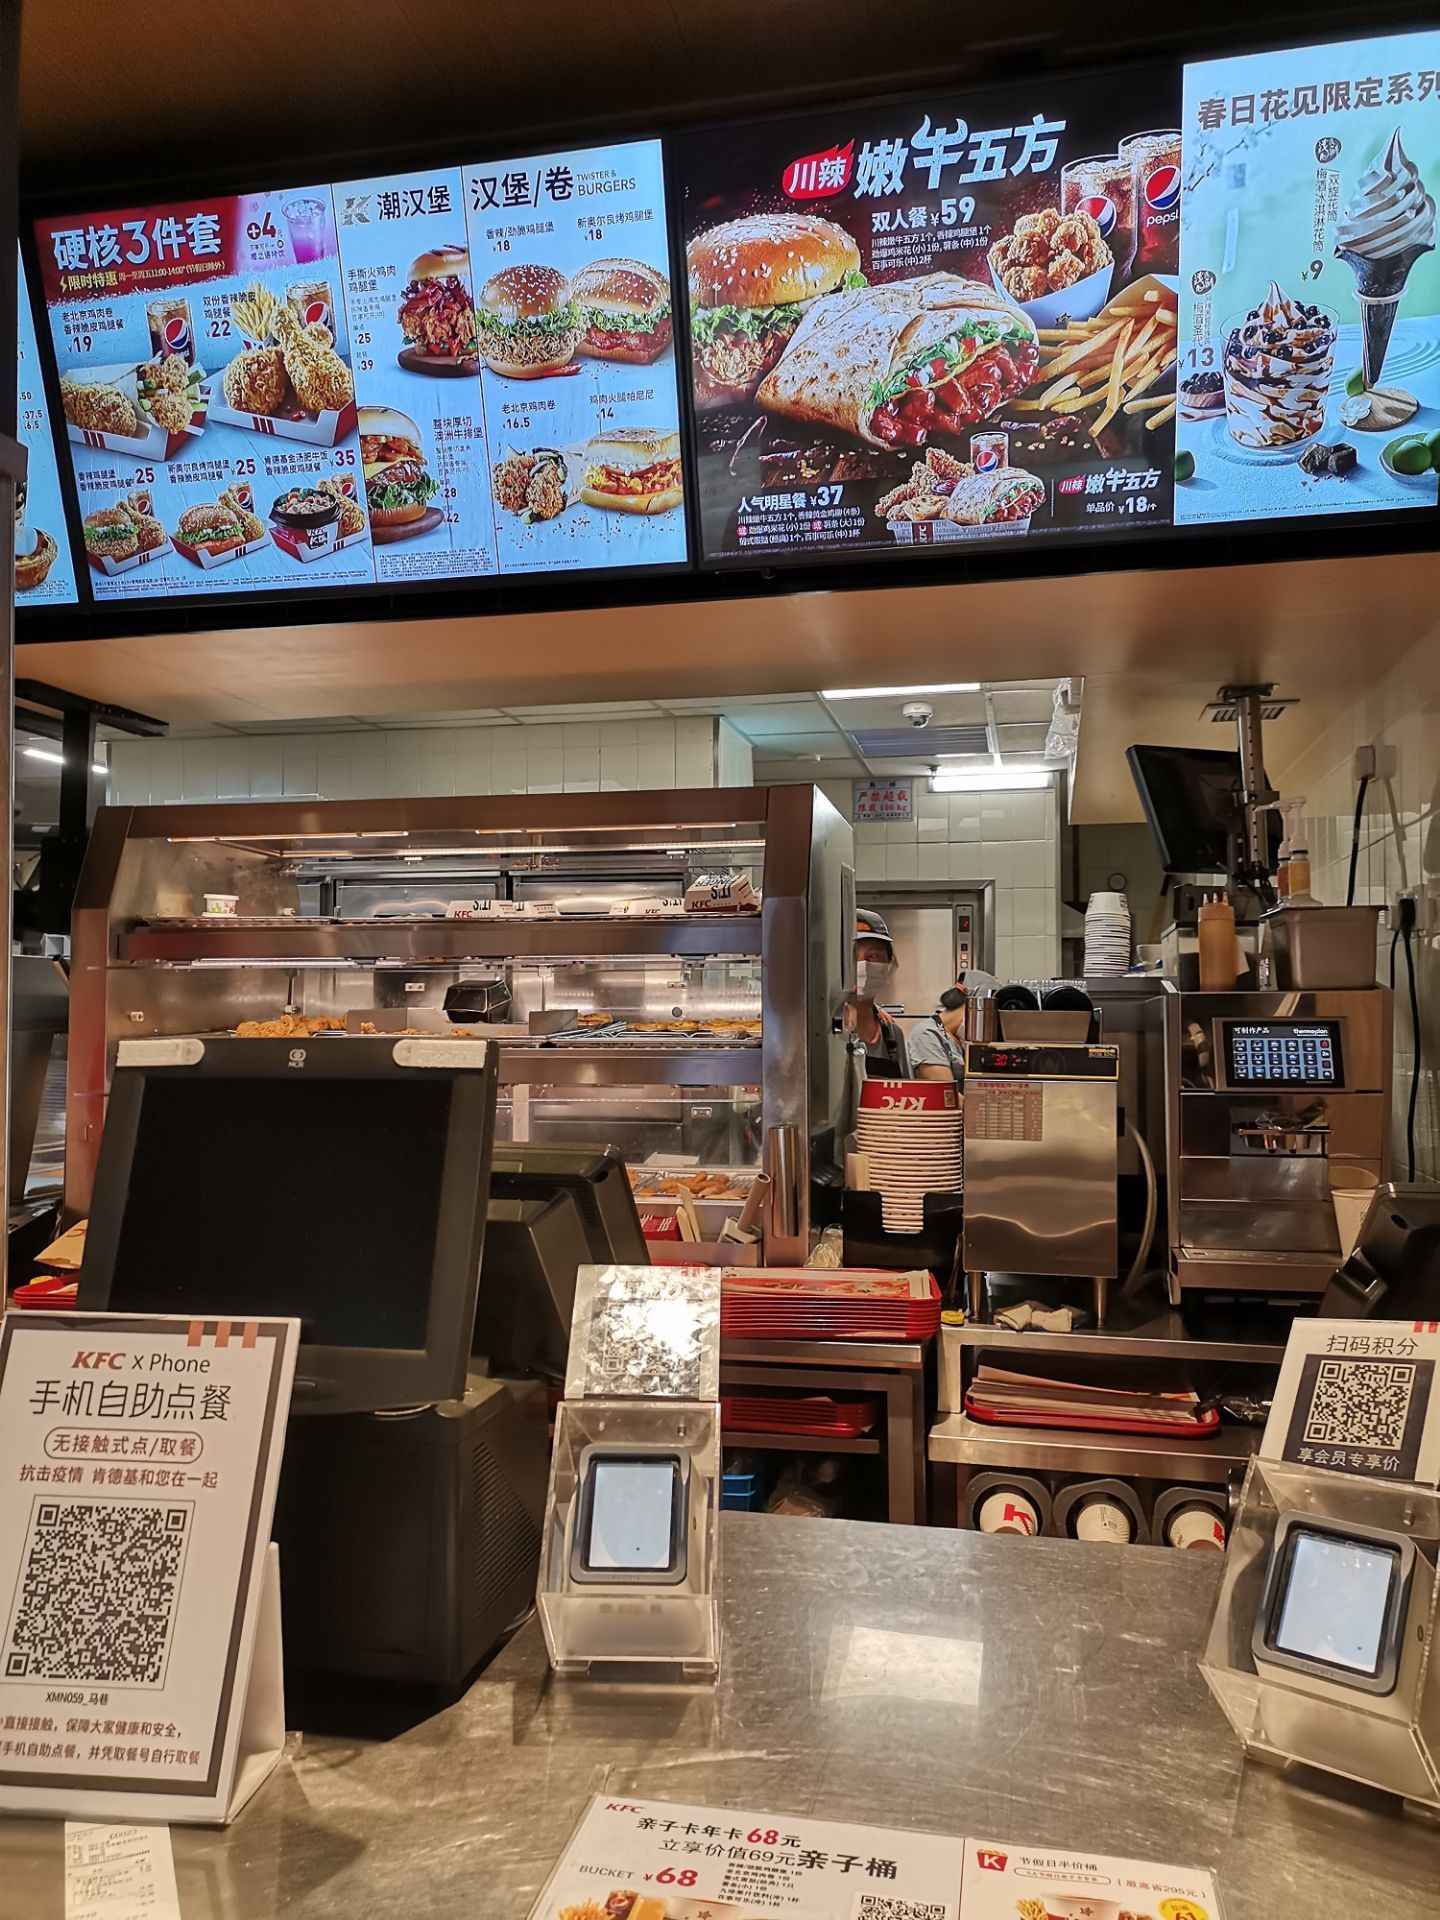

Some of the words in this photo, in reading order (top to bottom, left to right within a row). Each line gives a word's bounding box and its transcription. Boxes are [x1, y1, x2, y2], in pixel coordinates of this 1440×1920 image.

[1196, 69, 1440, 131] 春日花见限定系列
[853, 112, 1067, 199] 嫩牛五方
[576, 170, 610, 181] TWISTER
[788, 156, 847, 193] 川辣
[470, 166, 574, 211] 汉堡/卷
[577, 178, 636, 197] BURGERS
[377, 185, 452, 221] 潮汉堡
[930, 196, 976, 227] ¥59
[577, 208, 654, 229] 新奥尔良烤鸡腿堡
[872, 208, 929, 234] 双人餐
[50, 213, 222, 272] 硬核3件套
[68, 270, 118, 290] 限时特惠
[347, 264, 397, 280] 手撕火鸡肉
[1300, 259, 1323, 281] ¥9
[348, 280, 378, 293] 鸡腿堡
[61, 307, 113, 321] 老北京鸡肉卷
[204, 306, 231, 320] 鸡腿餐
[1178, 347, 1215, 369] ¥13
[501, 399, 556, 414] 老北京鸡肉卷
[1061, 479, 1083, 492] 川辣
[1084, 467, 1162, 494] 嫩牛五方
[737, 493, 806, 514] 人气明星餐
[810, 484, 844, 507] ¥37
[1085, 501, 1115, 514] 单品价
[454, 910, 473, 918] KFC
[1326, 1335, 1419, 1356] 扫码积分
[71, 1351, 126, 1370] KFC
[149, 1353, 211, 1373] Phone
[29, 1380, 232, 1421] 手机自助点餐
[52, 1434, 197, 1458] 无接触式点/取餐
[1297, 1447, 1401, 1472] 享会员专享价
[19, 1464, 84, 1484] 抗击疫情
[92, 1468, 219, 1490] 肯德基和您在一起
[45, 1692, 109, 1706] XMN059_马巷
[604, 1802, 644, 1814] KFC
[637, 1817, 802, 1849] 亲子卡年卡68元
[658, 1839, 897, 1880] 立享价值69元亲子桶
[578, 1864, 636, 1880] BUCKET
[643, 1867, 698, 1888] ¥68
